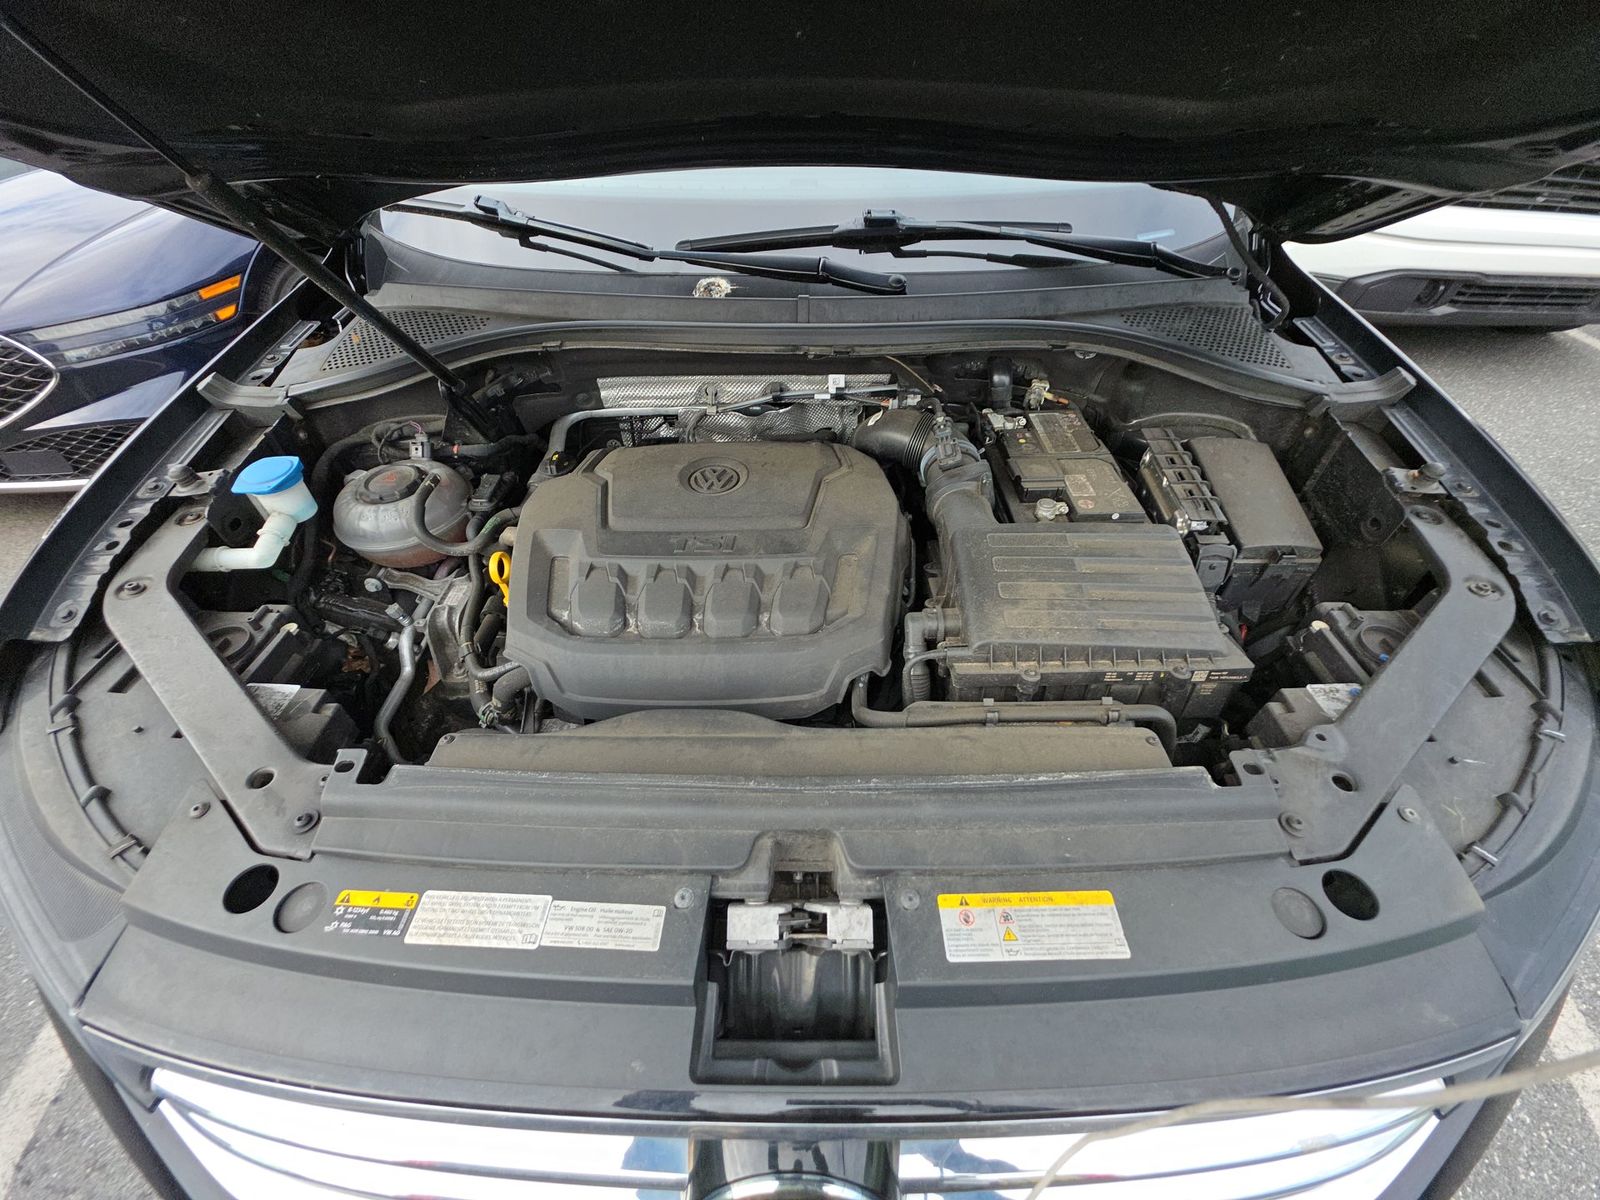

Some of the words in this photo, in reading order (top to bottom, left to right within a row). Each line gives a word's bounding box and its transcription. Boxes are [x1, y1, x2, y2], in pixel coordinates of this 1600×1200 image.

[688, 464, 740, 495] VW
[671, 535, 737, 554] TSI
[982, 896, 1012, 904] WARNING
[1018, 895, 1053, 903] ATTENTION
